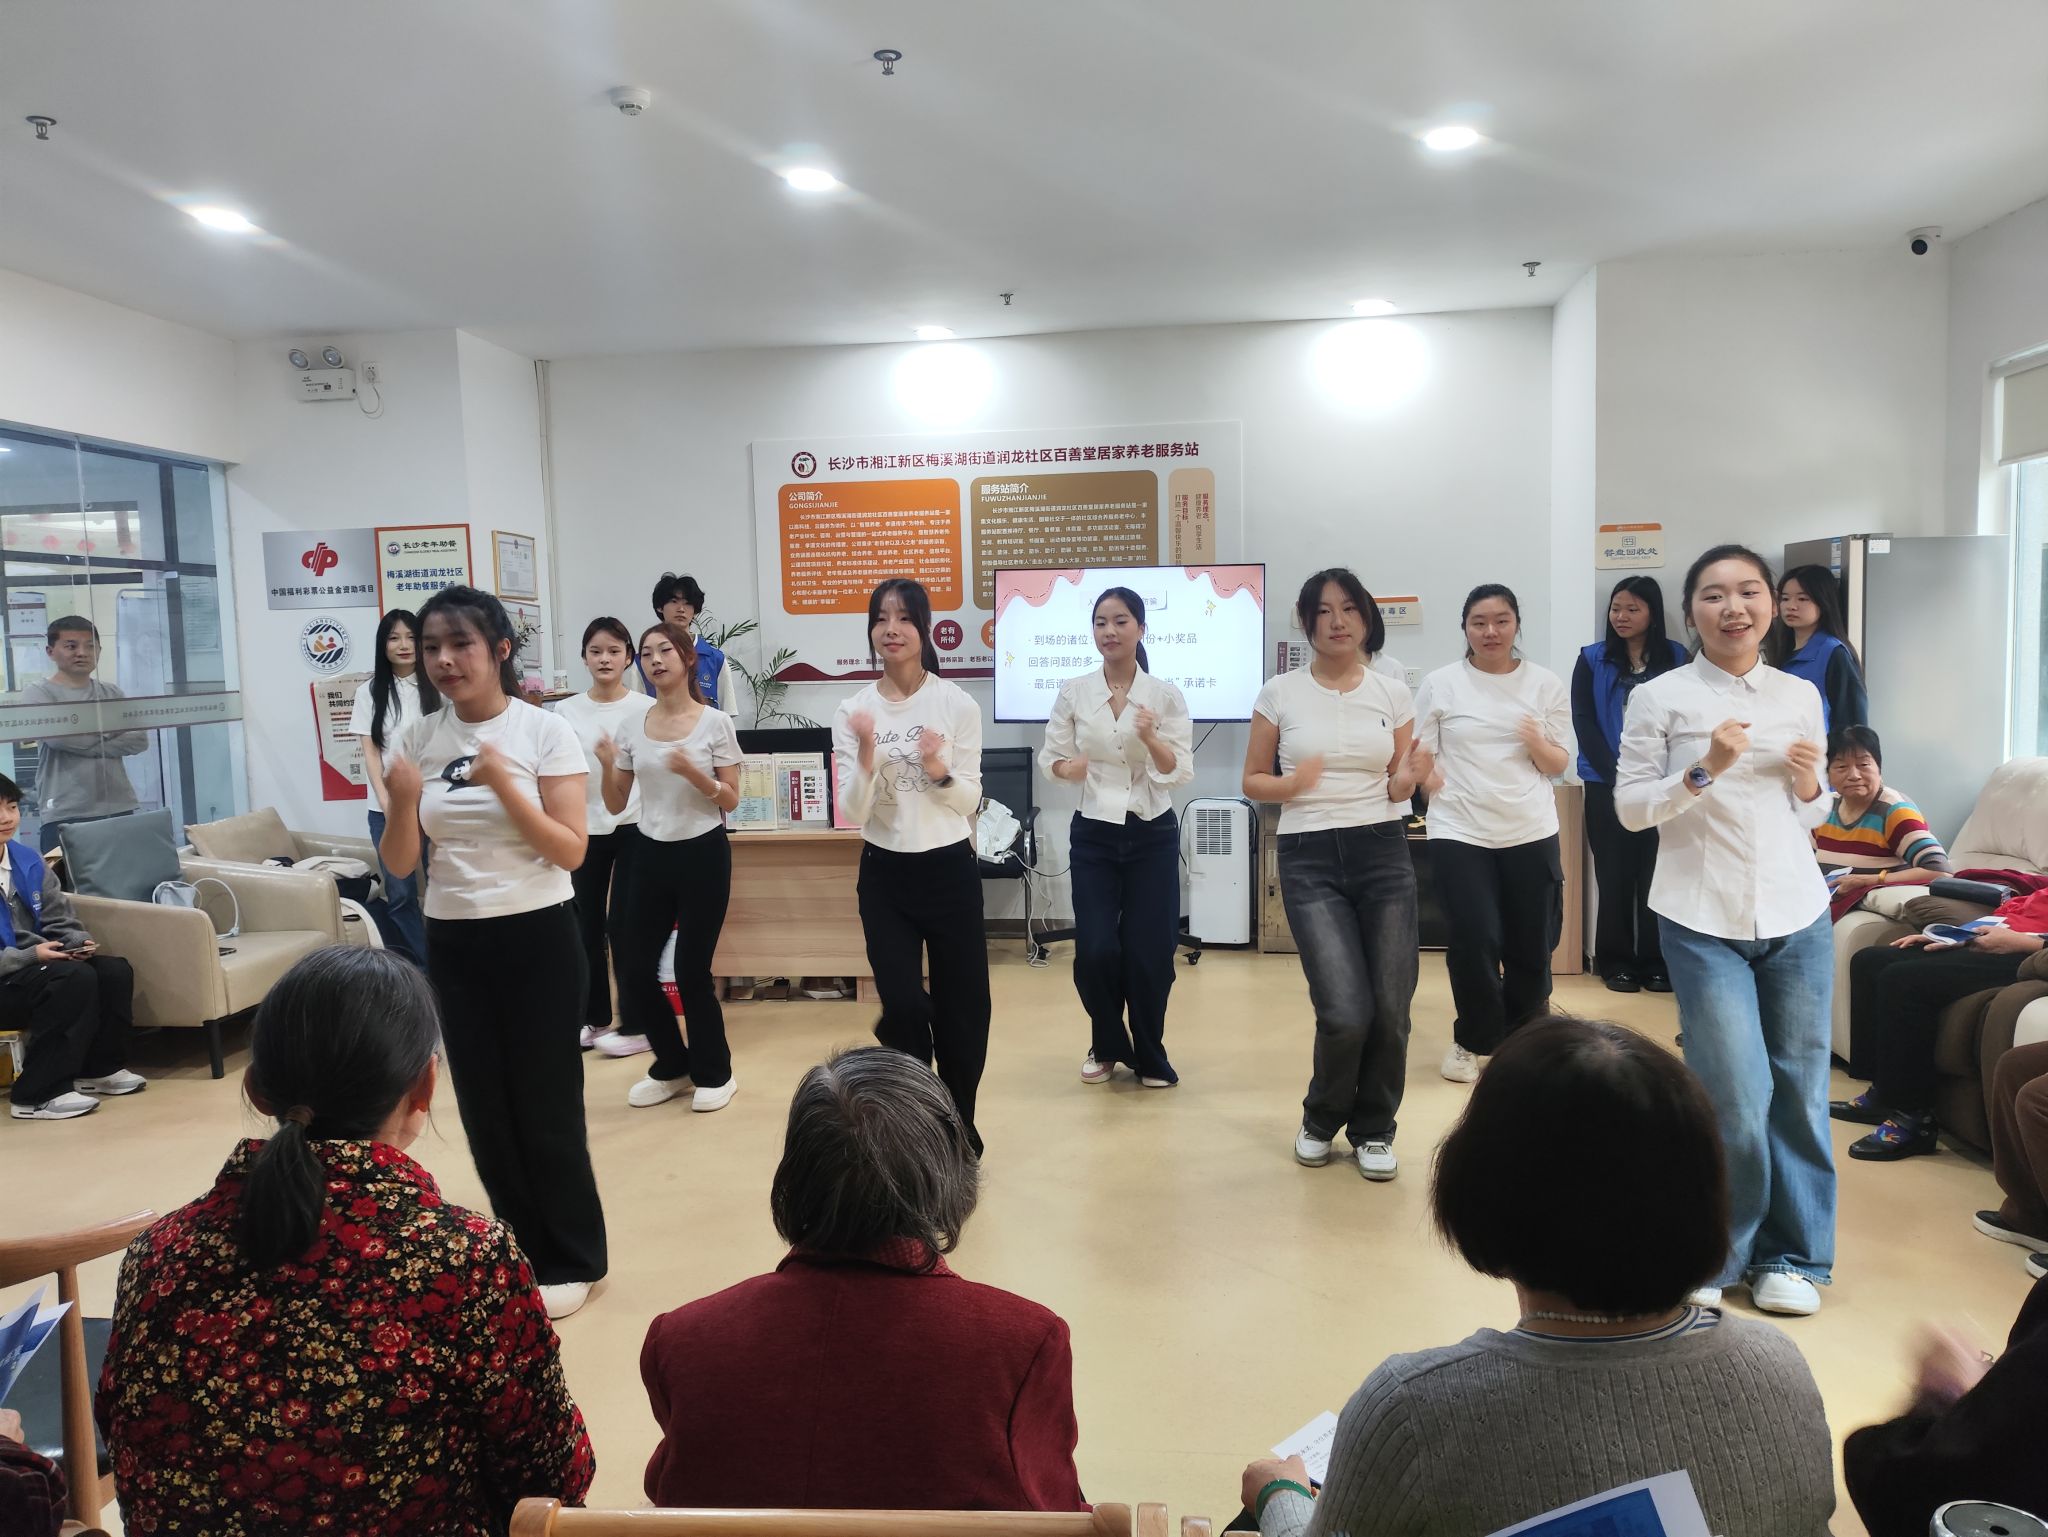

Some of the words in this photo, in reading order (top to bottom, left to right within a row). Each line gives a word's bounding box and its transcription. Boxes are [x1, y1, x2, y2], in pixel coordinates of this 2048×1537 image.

[828, 442, 1199, 471] 长沙市湘江新区梅溪湖街道润龙社区百善堂居家养老服务站
[981, 483, 1029, 495] 服务站简介
[789, 491, 823, 501] 公司简介
[981, 494, 1047, 502] FUWUZHANJIANJIE
[789, 501, 839, 509] GONGSIJIANJIE
[402, 540, 457, 549] 长沙老年助餐
[386, 567, 463, 579] 梅溪湖街道润龙社区
[271, 584, 374, 597] 中国福利彩票公益金资助项目
[940, 626, 955, 635] 老有
[940, 635, 956, 645] 所依
[327, 691, 343, 699] 我们
